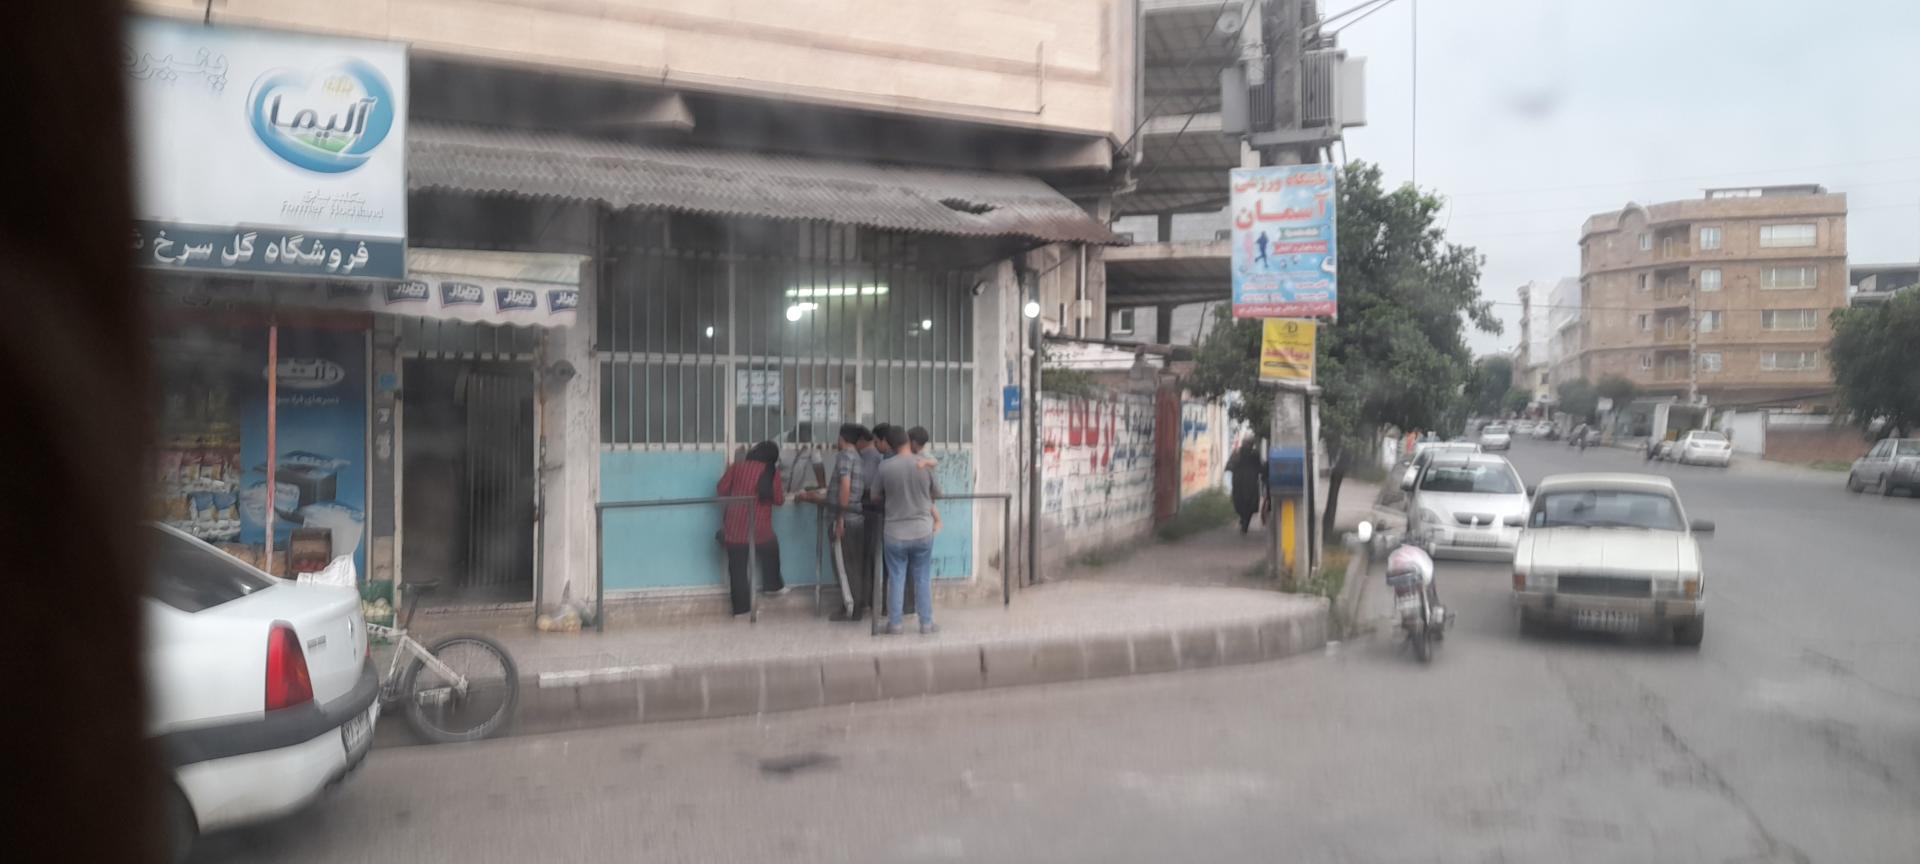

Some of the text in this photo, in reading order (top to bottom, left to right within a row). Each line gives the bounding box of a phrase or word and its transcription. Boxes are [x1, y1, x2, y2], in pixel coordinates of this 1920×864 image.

[270, 94, 377, 139] آلیما
[1235, 171, 1328, 193] باشگاه ورزشی
[1236, 191, 1329, 231] آسمان
[153, 230, 213, 264] سرخ
[221, 231, 258, 266] گل
[264, 235, 369, 271] فروشگاه
[449, 282, 481, 300] هراز
[503, 288, 534, 306] هراز
